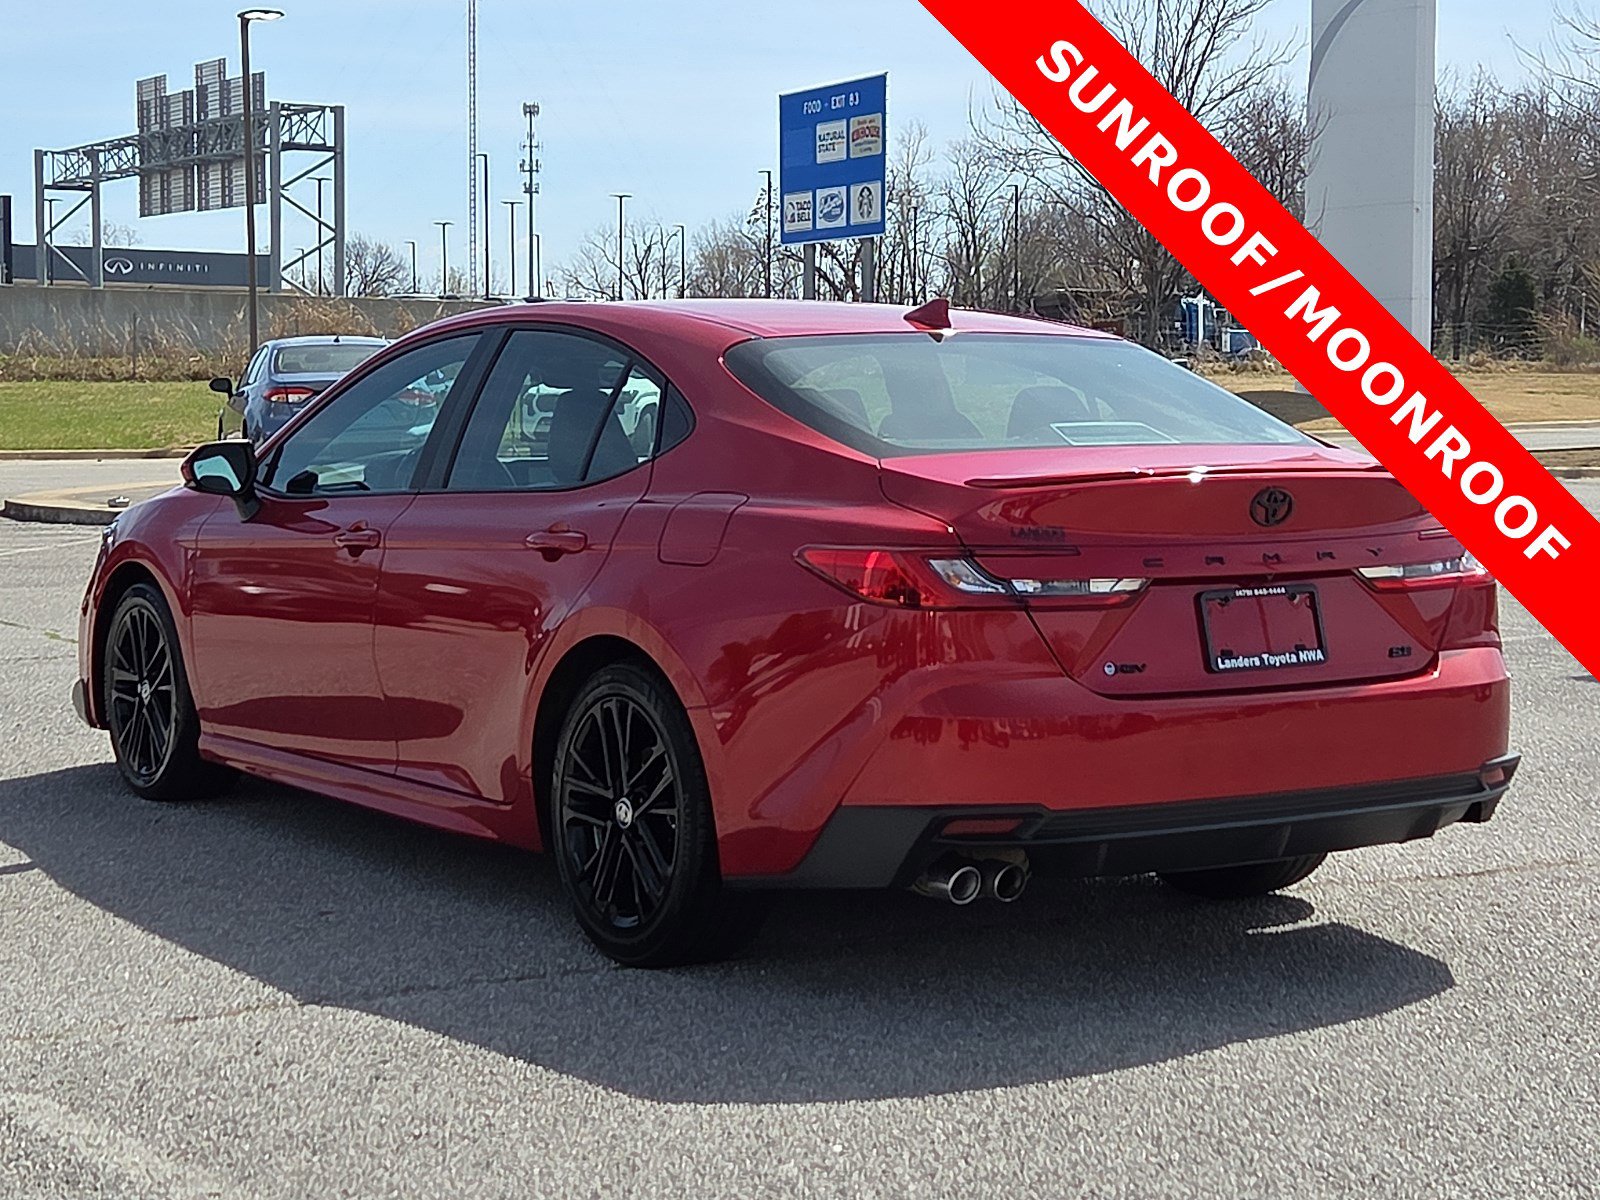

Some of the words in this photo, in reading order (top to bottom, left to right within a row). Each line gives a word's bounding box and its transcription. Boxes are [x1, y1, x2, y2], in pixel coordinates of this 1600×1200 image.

[803, 101, 821, 114] FOOD
[831, 94, 846, 110] EXIT
[818, 130, 845, 143] NATURAL
[818, 142, 836, 153] STATE
[796, 200, 811, 210] TACO
[797, 211, 811, 222] BELL
[140, 262, 208, 273] INFINITI
[1142, 547, 1383, 568] CAMRY
[1218, 656, 1260, 669] Landers
[1262, 652, 1298, 667] Toyota
[1299, 649, 1324, 662] NWA
